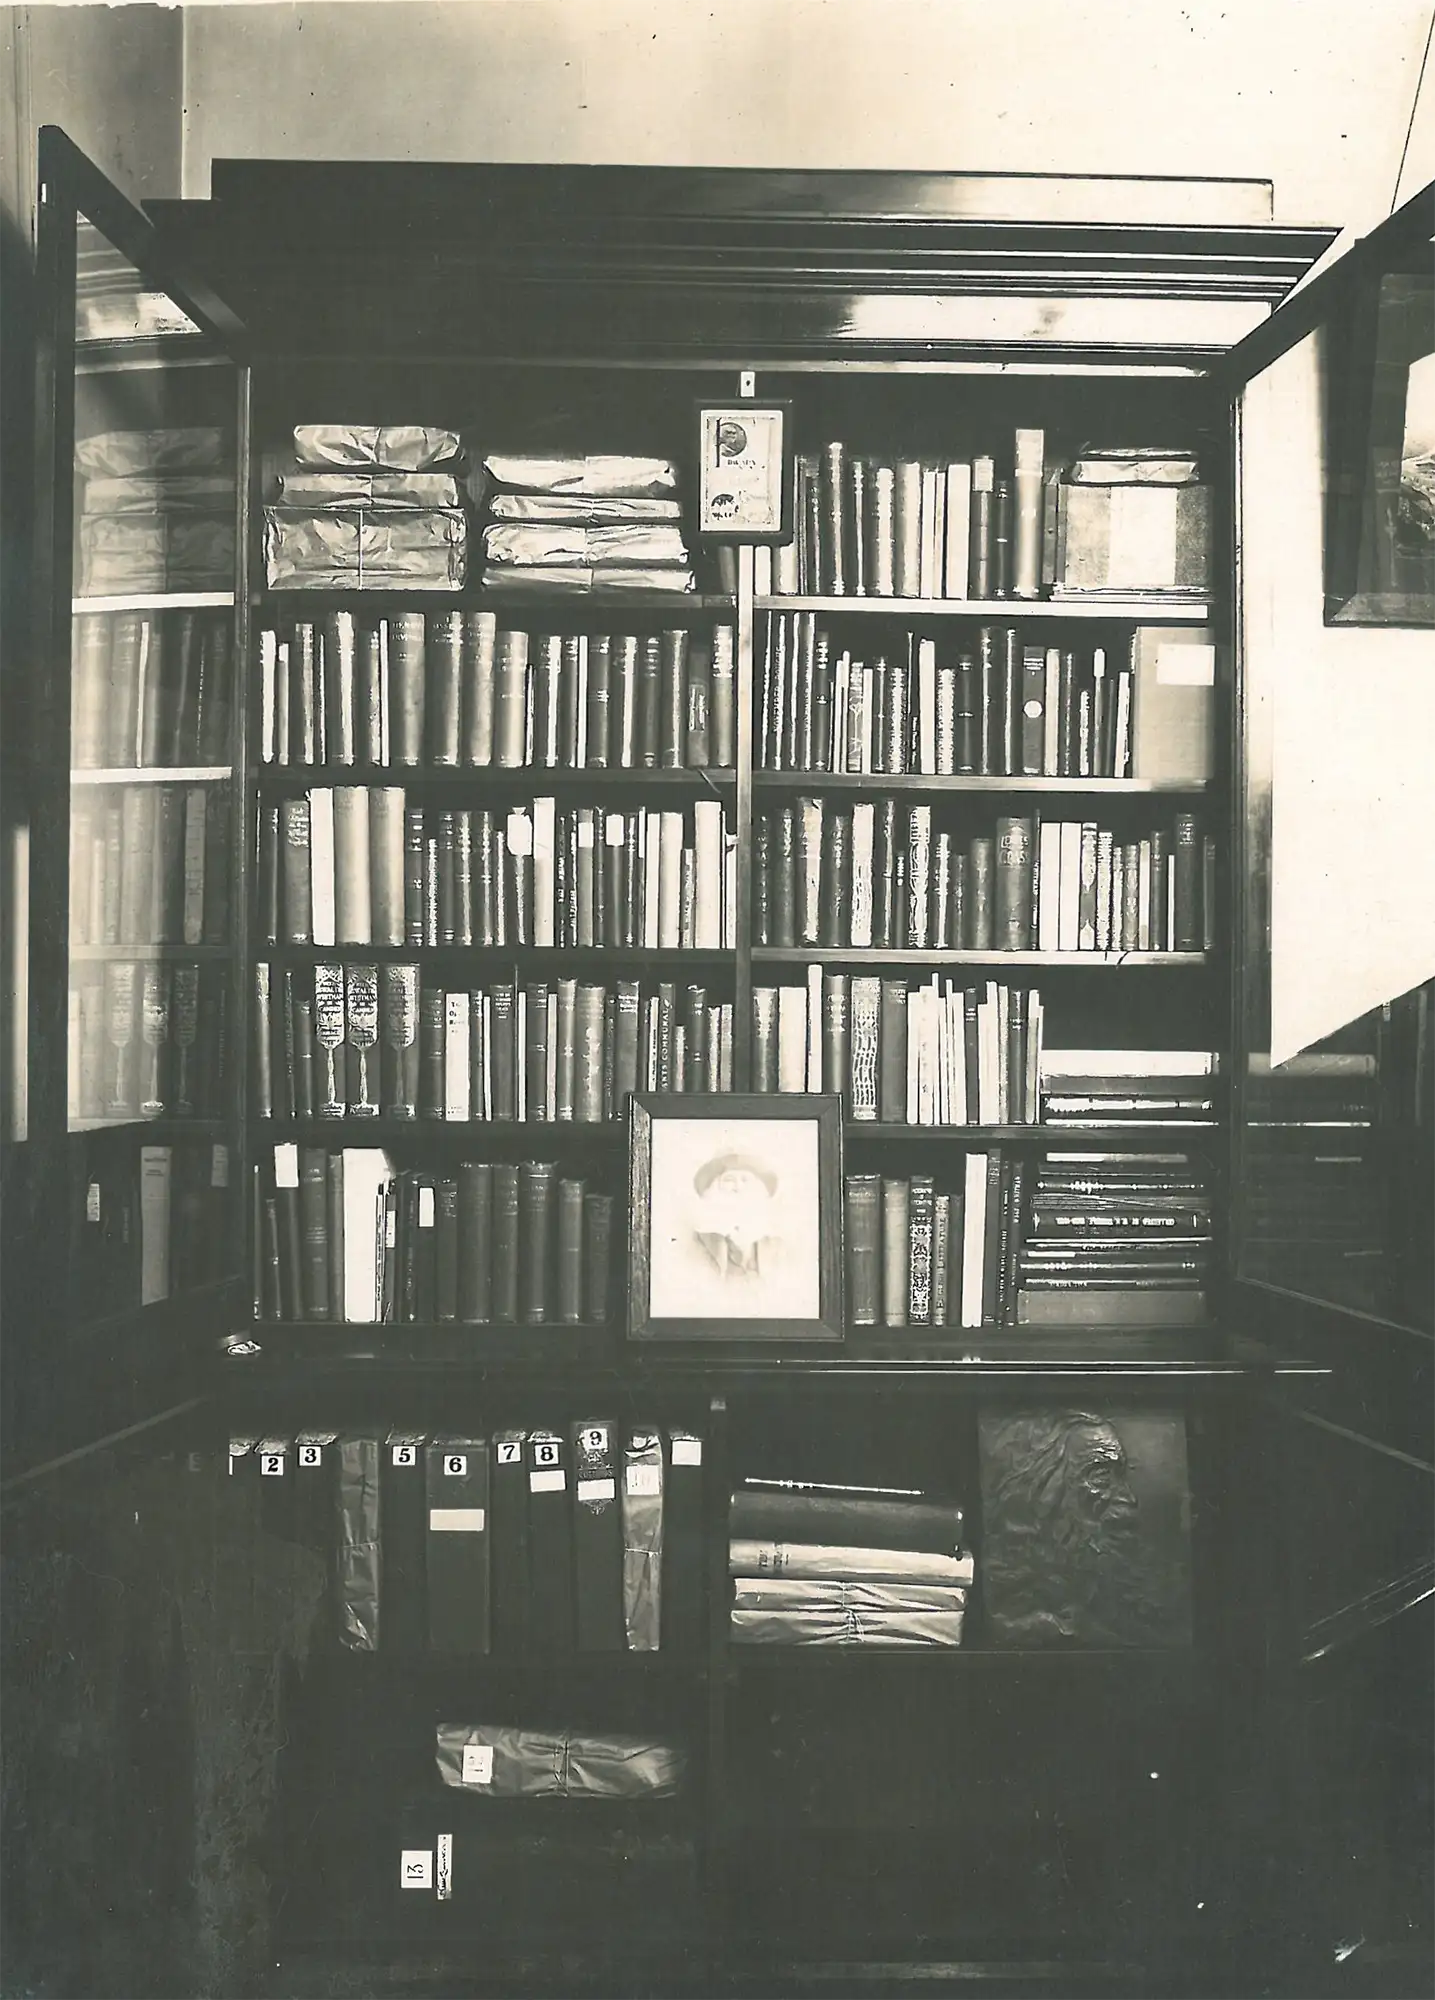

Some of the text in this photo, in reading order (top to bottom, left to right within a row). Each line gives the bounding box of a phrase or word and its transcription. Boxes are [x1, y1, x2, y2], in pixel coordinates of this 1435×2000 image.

[661, 1065, 669, 1091] ANTS
[590, 1430, 602, 1446] 9
[304, 1448, 317, 1463] 3
[398, 1447, 411, 1463] 5
[503, 1445, 516, 1460] 7
[540, 1446, 554, 1462] 8
[267, 1457, 279, 1473] 2
[448, 1457, 463, 1473] 6
